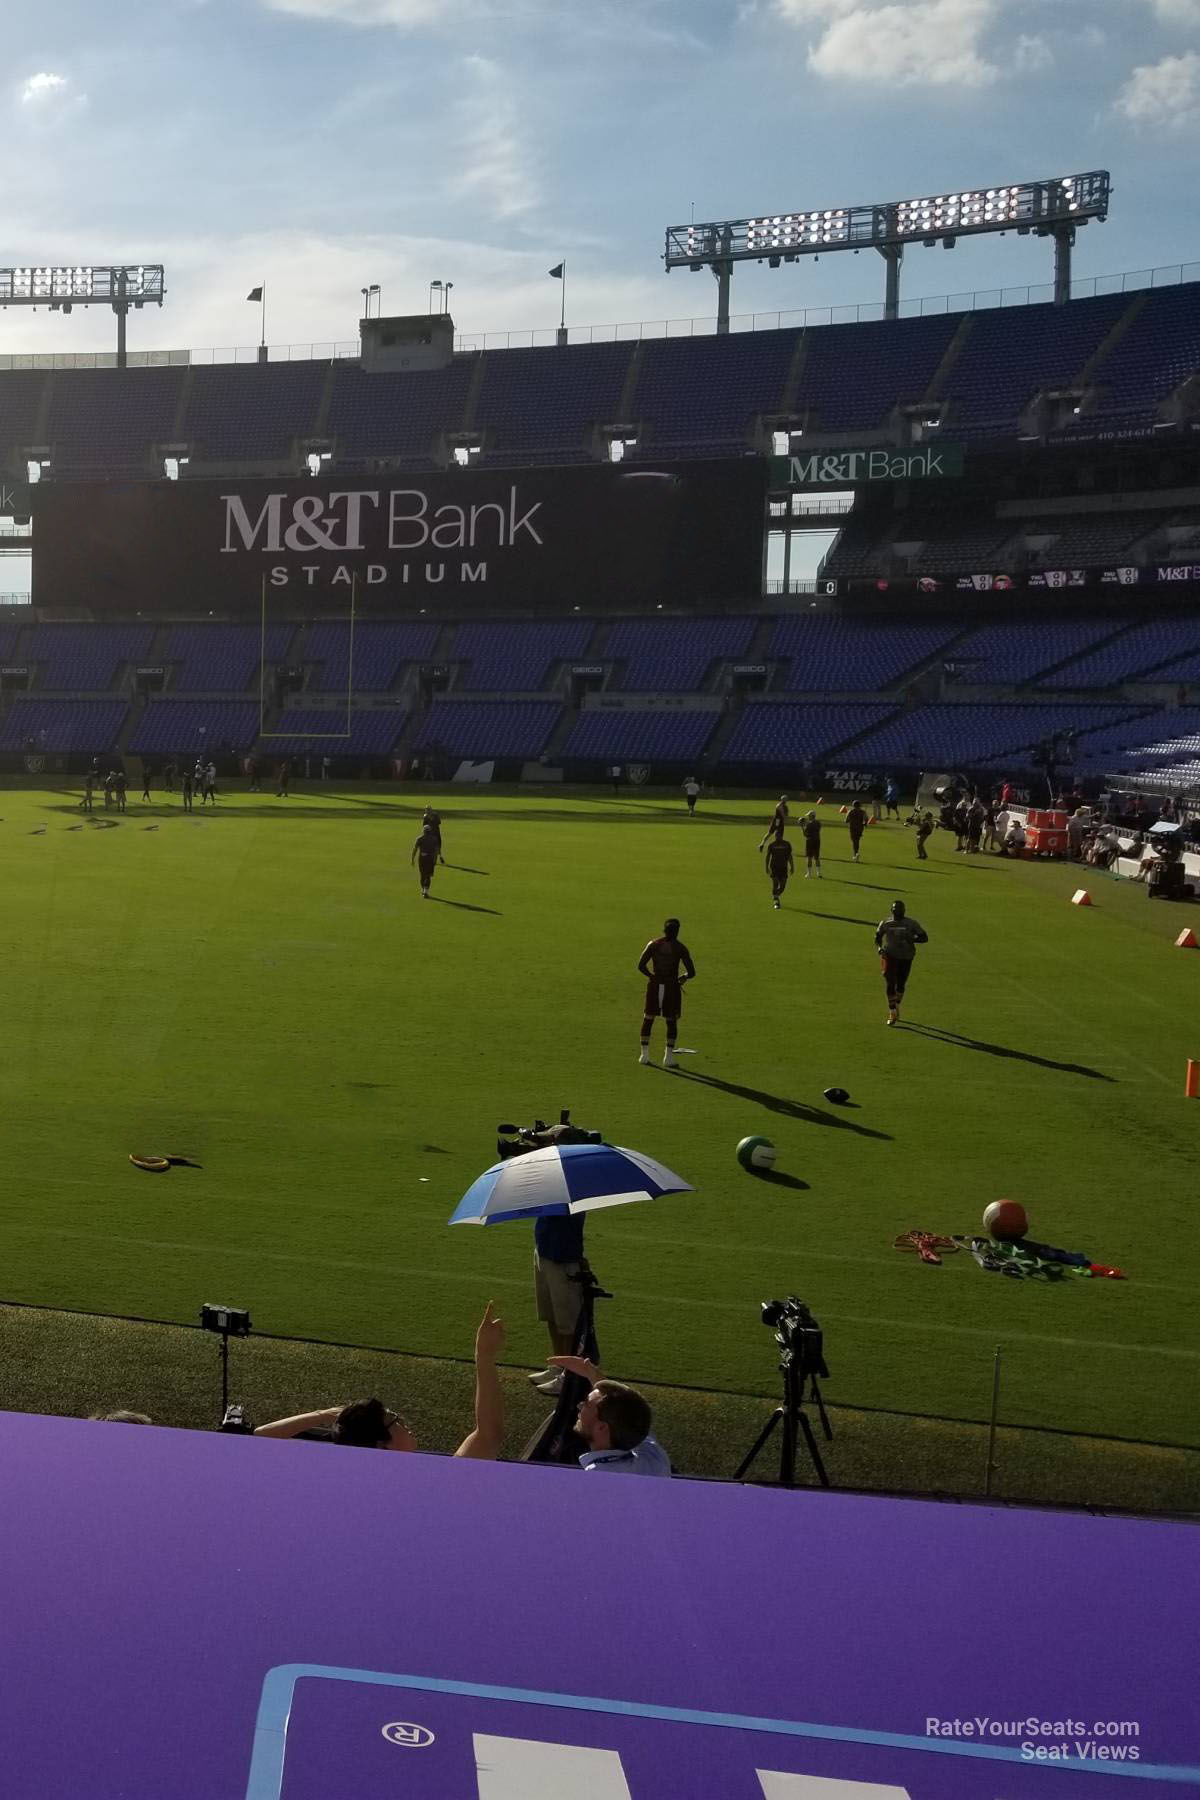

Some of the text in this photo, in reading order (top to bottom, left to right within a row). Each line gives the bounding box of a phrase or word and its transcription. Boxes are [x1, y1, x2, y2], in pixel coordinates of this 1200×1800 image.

[788, 449, 944, 484] M&T Bank
[219, 485, 544, 553] M&T Bank
[269, 561, 488, 586] STADIUM
[1157, 565, 1192, 581] M&T
[826, 582, 834, 594] 0
[824, 771, 858, 780] PLAY
